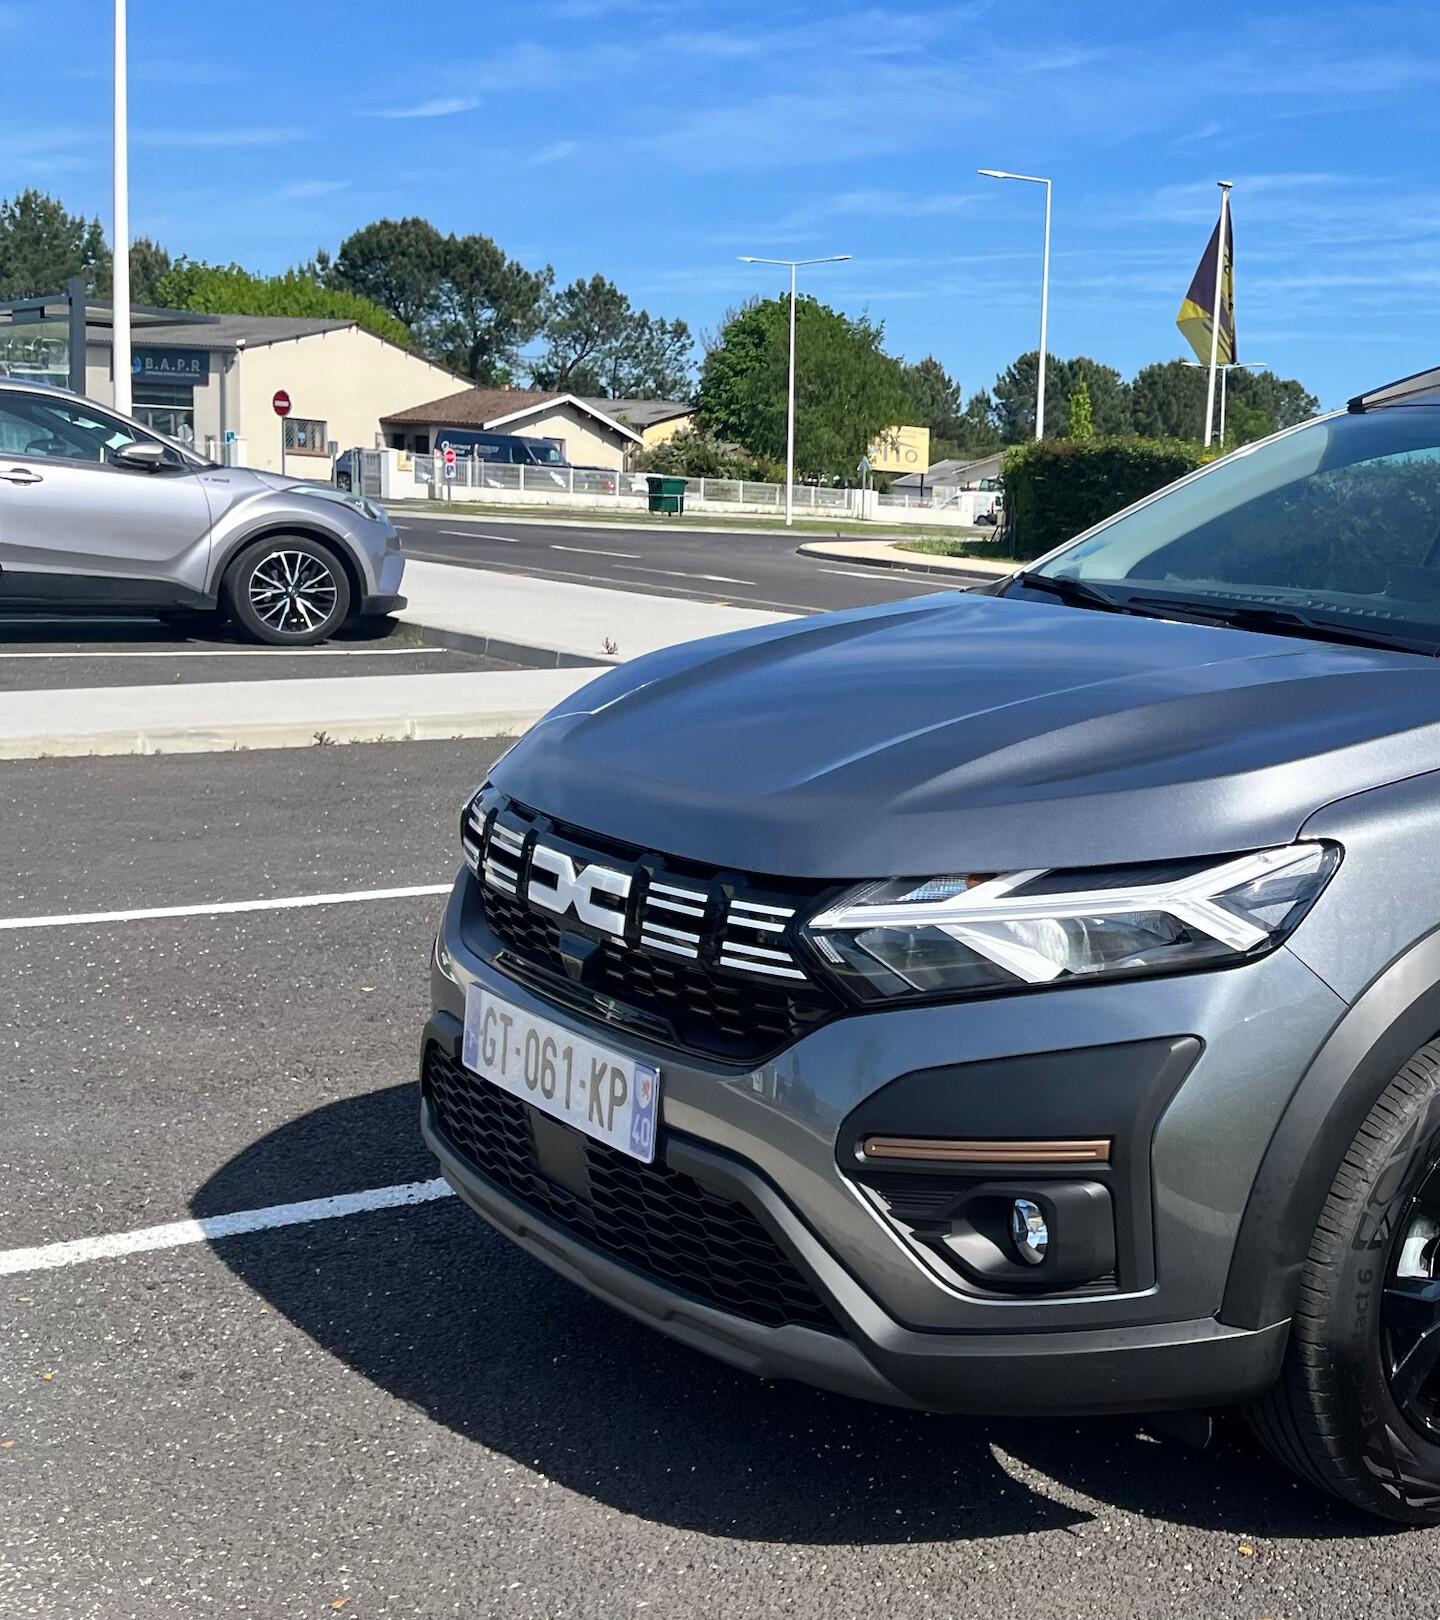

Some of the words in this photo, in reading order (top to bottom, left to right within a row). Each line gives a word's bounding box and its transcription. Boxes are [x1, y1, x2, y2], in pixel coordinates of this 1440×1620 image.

[144, 357, 200, 371] B.A.P.R
[482, 1006, 628, 1132] GT-061-KP
[632, 1113, 650, 1148] 40
[1356, 1268, 1373, 1285] 6
